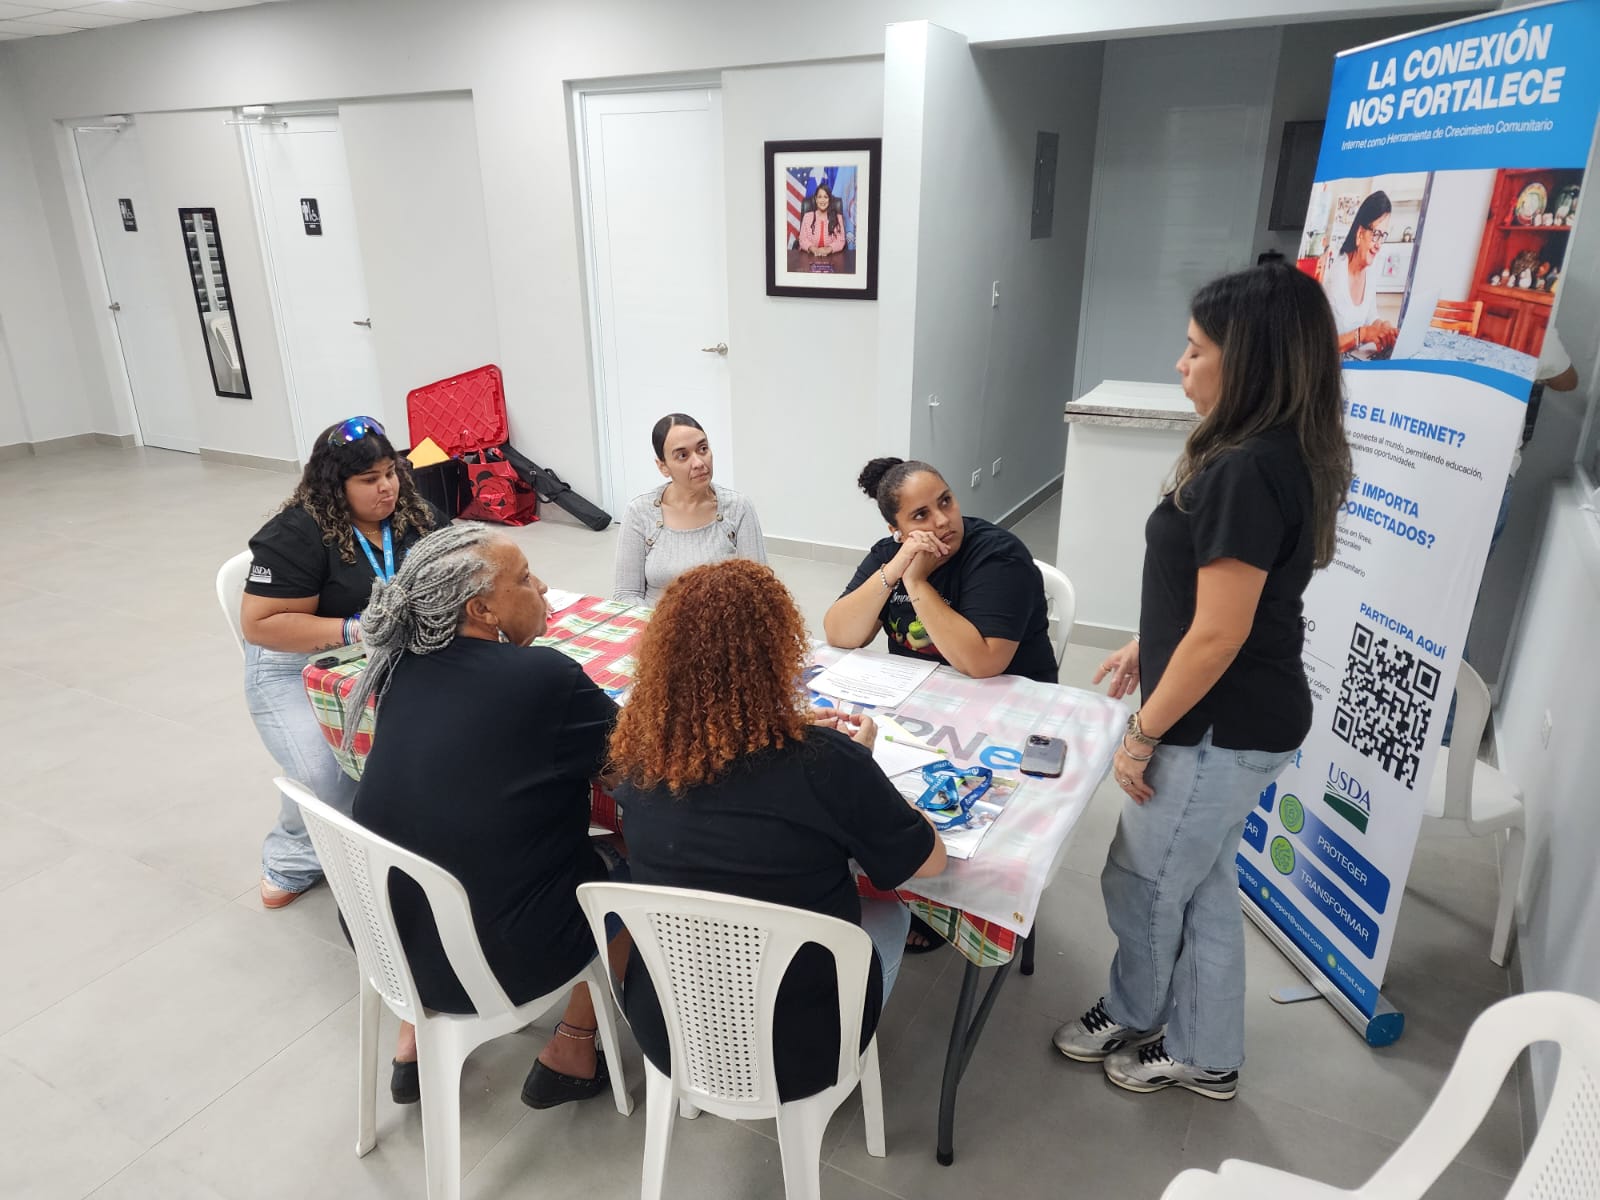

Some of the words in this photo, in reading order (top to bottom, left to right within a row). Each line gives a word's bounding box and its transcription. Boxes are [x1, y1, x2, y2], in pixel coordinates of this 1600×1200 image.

[1367, 57, 1397, 90] LA
[1403, 19, 1553, 82] CONEXIÓN
[1345, 96, 1394, 129] NOS
[1397, 67, 1566, 120] FORTALECE
[1341, 139, 1367, 151] Internet
[1367, 138, 1386, 148] como
[1387, 129, 1432, 145] Herramienta
[1432, 127, 1443, 139] de
[1444, 122, 1495, 138] Crecimiento
[1495, 118, 1554, 134] Comunitario
[1350, 403, 1368, 420] ES
[1370, 407, 1386, 424] EL
[1389, 411, 1466, 448] INTERNET?
[1352, 431, 1377, 442] conecta
[1378, 436, 1384, 444] al
[1405, 447, 1445, 465] permitiendo
[1445, 459, 1483, 480] educación,
[1374, 448, 1416, 469] oportunidades.
[1361, 482, 1419, 518] IMPORTA
[1359, 602, 1414, 642] PARTICIPA
[1416, 635, 1447, 660] AQUÍ
[1328, 762, 1370, 812] USDA
[1317, 835, 1368, 887] PROTEGER
[1301, 870, 1369, 941] TRANSFORMAR
[1270, 896, 1323, 953] support@vpnet.com
[1337, 964, 1366, 997] vpnet.net
